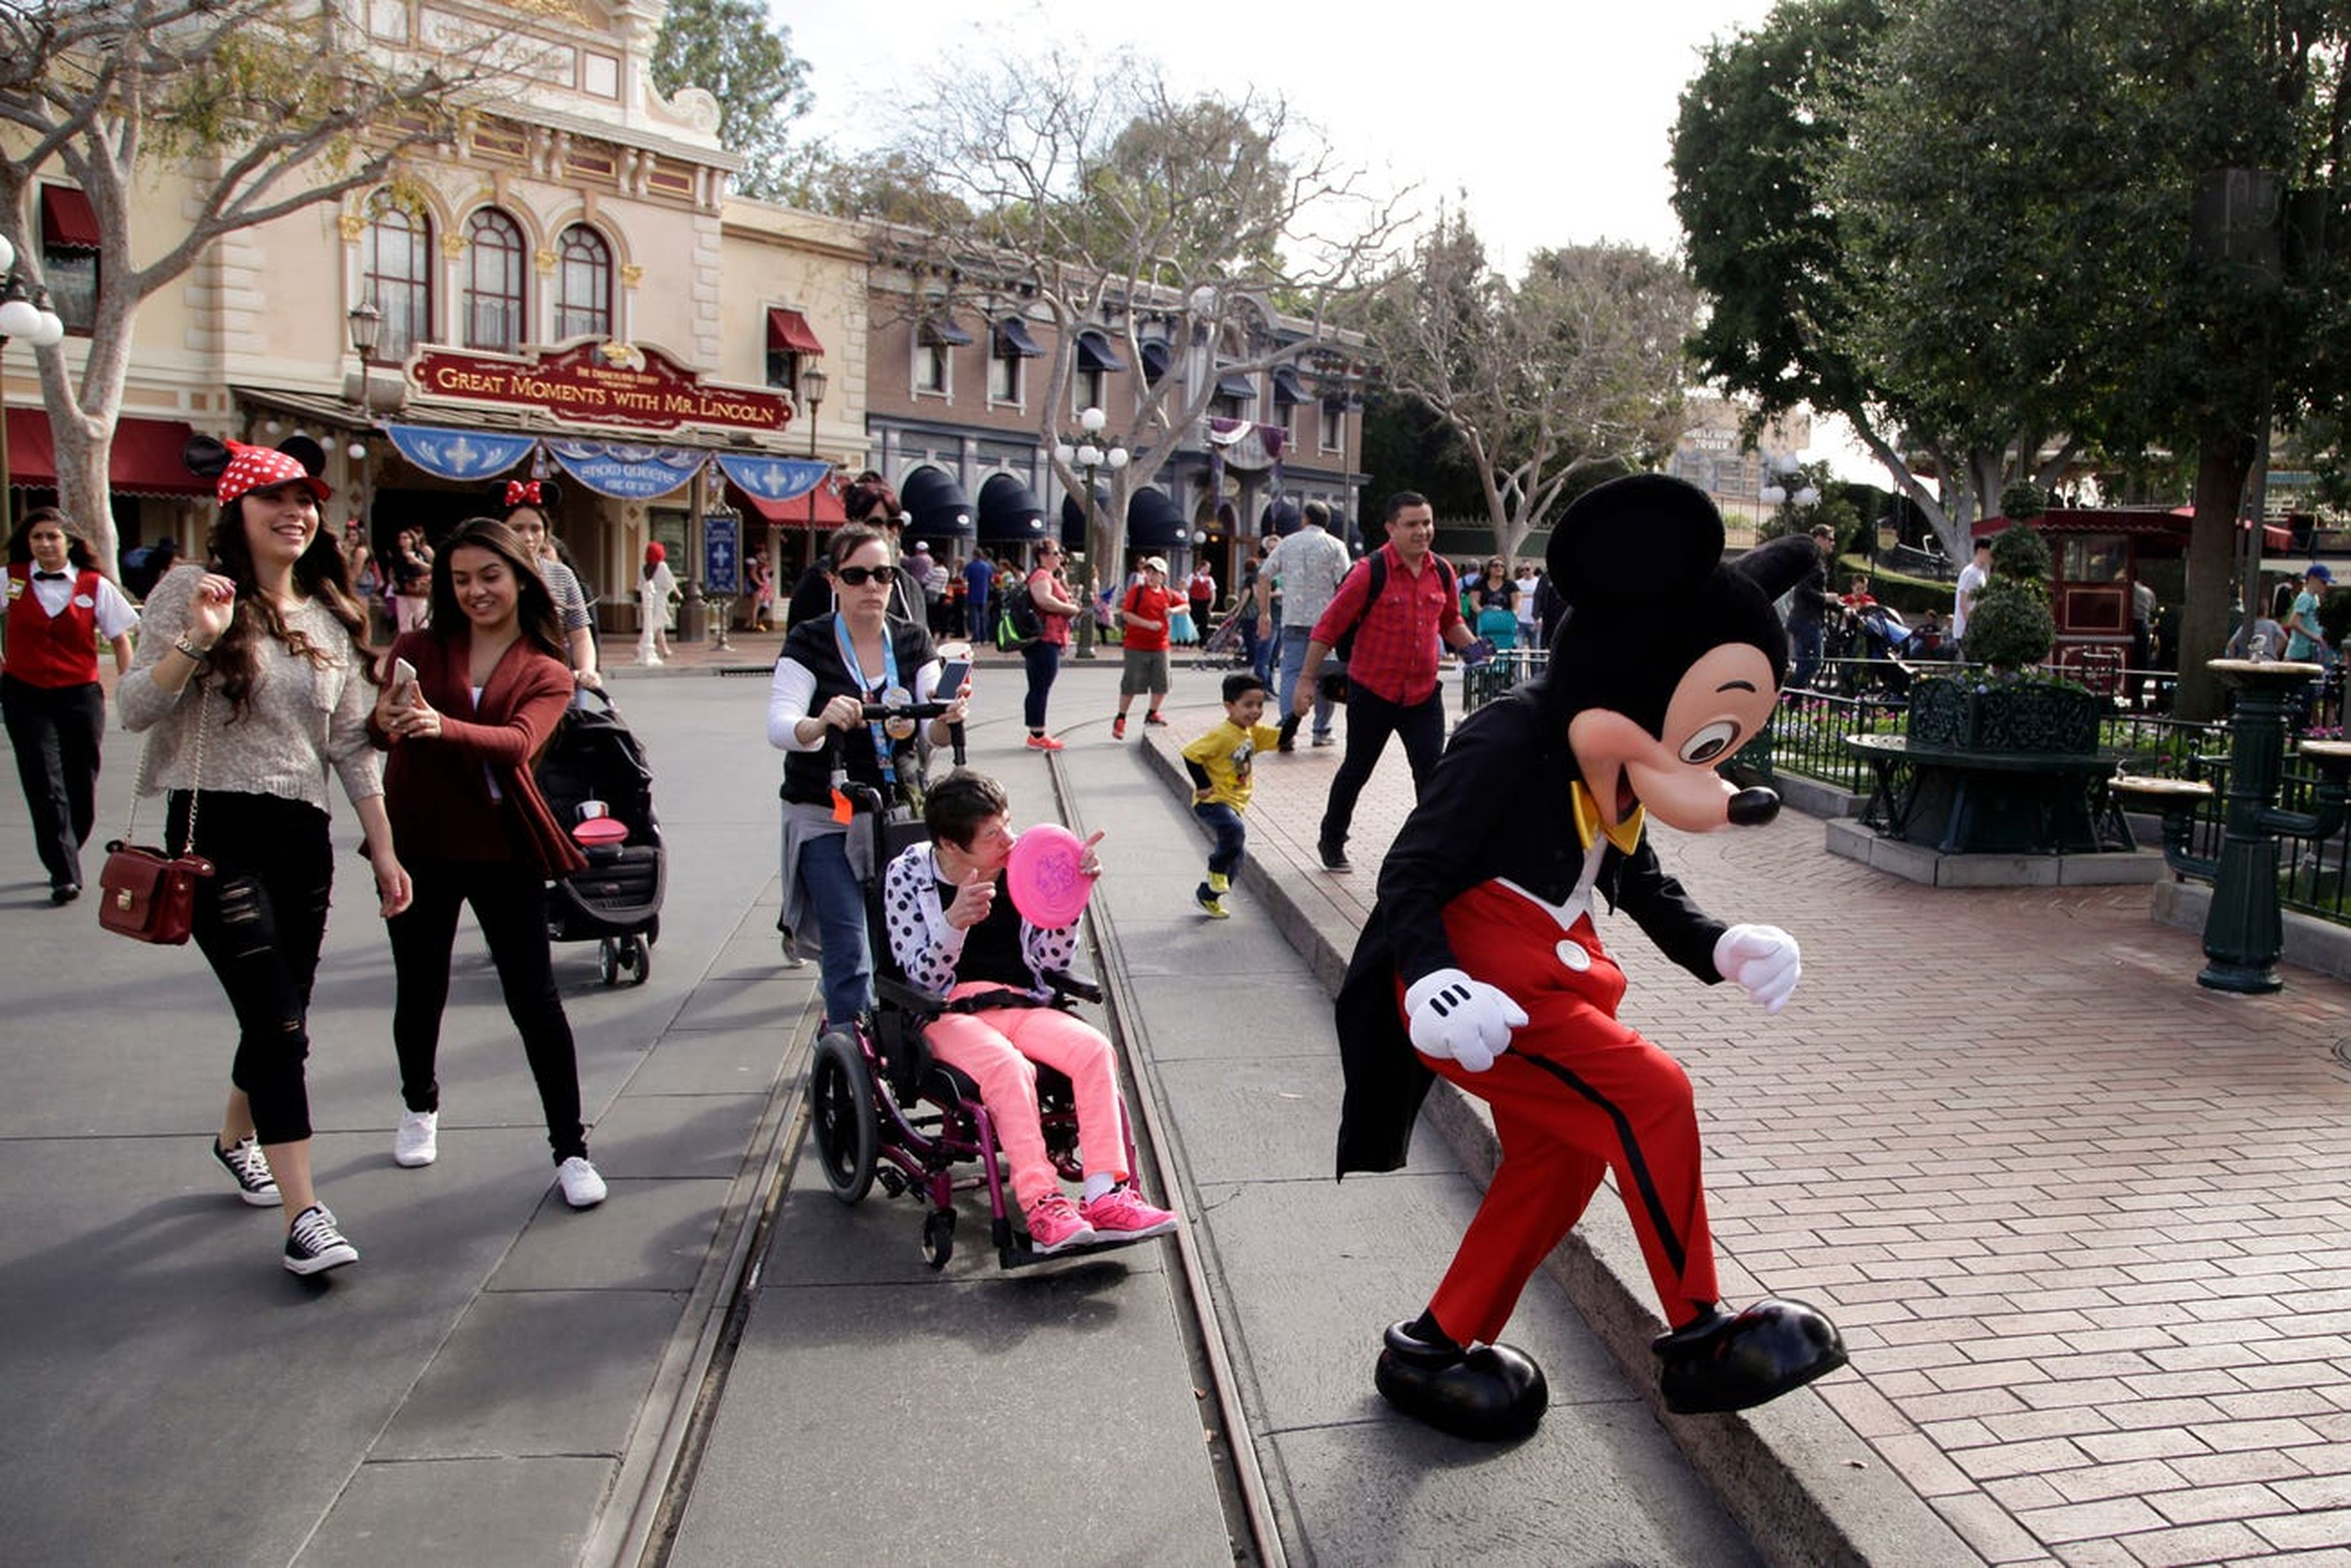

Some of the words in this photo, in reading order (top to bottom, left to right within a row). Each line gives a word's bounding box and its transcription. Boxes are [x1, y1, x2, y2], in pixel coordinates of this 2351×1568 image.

[437, 367, 504, 392] GREAT
[511, 375, 606, 405] MOMENTS
[612, 391, 659, 411] WITH
[664, 394, 697, 415] MR.
[700, 398, 774, 422] LINCOLN
